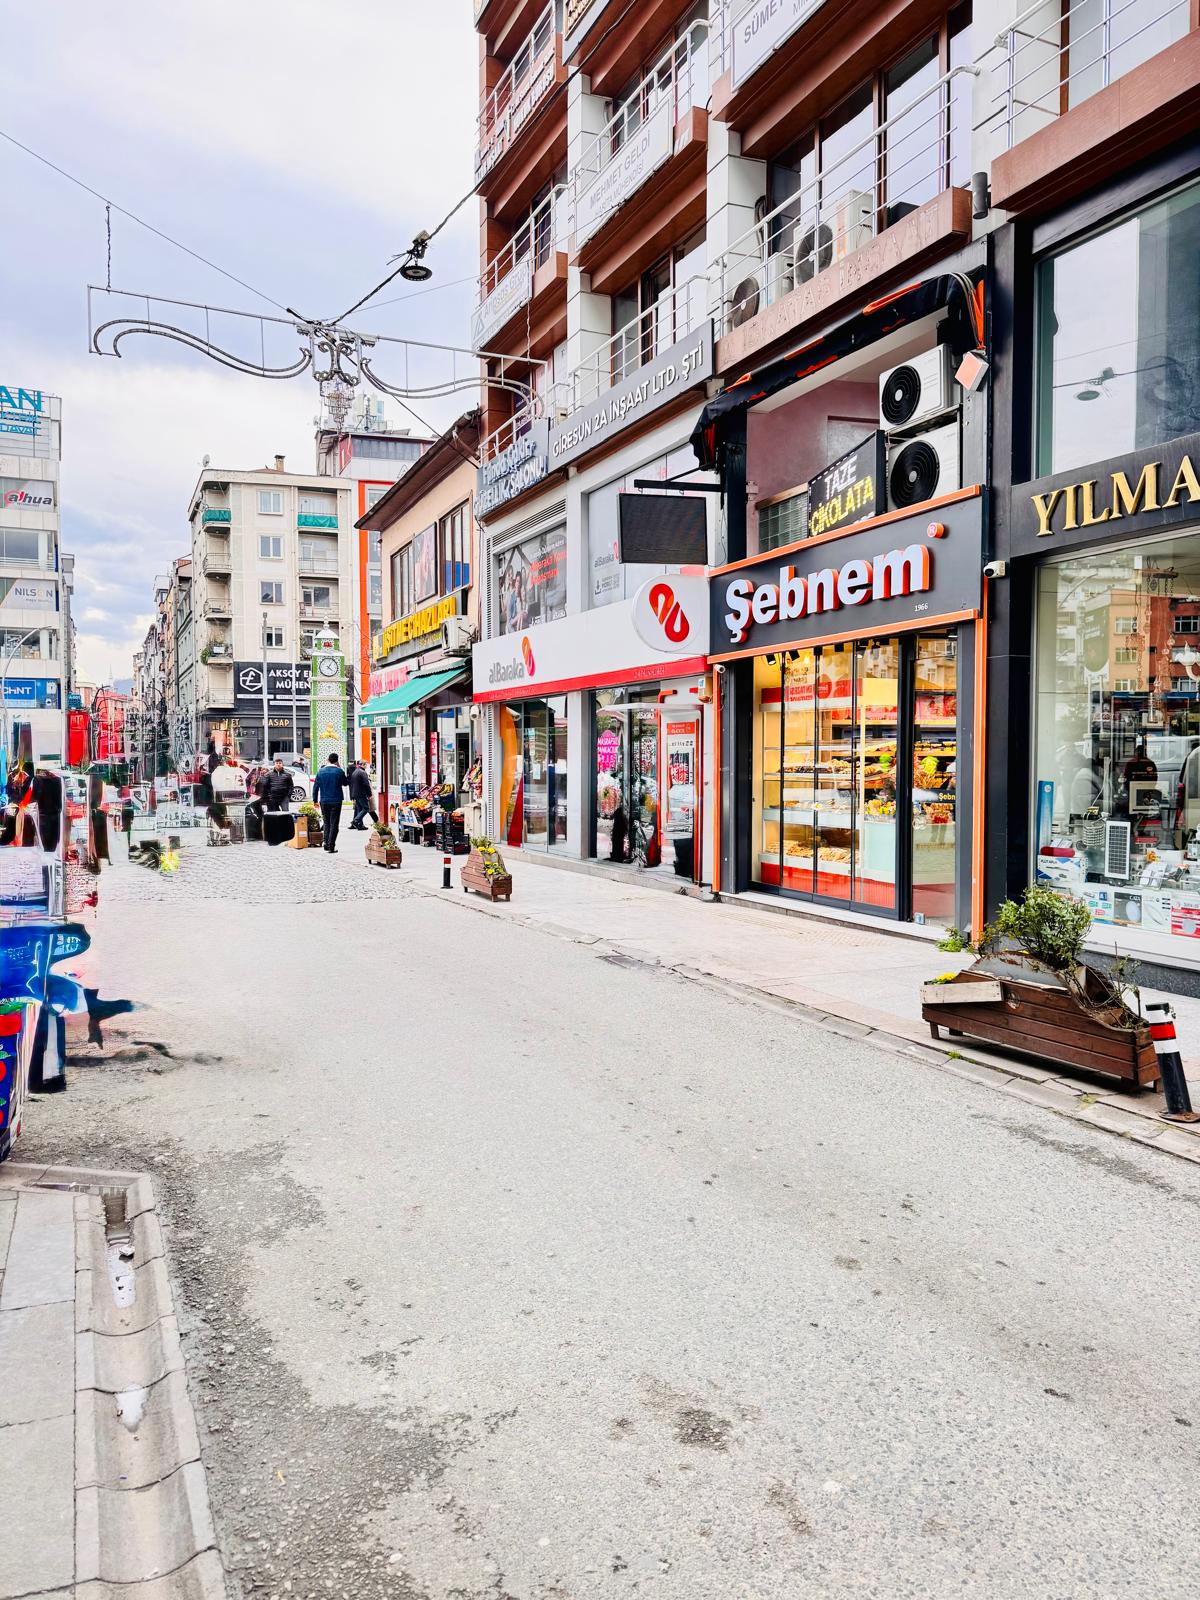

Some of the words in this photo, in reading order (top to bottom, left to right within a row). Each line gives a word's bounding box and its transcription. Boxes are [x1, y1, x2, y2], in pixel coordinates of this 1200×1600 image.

[552, 418, 592, 458] GİRESUN
[609, 380, 651, 423] İNŞAAT
[652, 365, 680, 395] LTD.
[682, 340, 704, 382] ŞTİ
[824, 455, 858, 500] TAZE
[1030, 454, 1200, 538] YILMA
[724, 543, 930, 645] Şebnem
[914, 602, 929, 612] 1966
[489, 658, 525, 684] alBaraka
